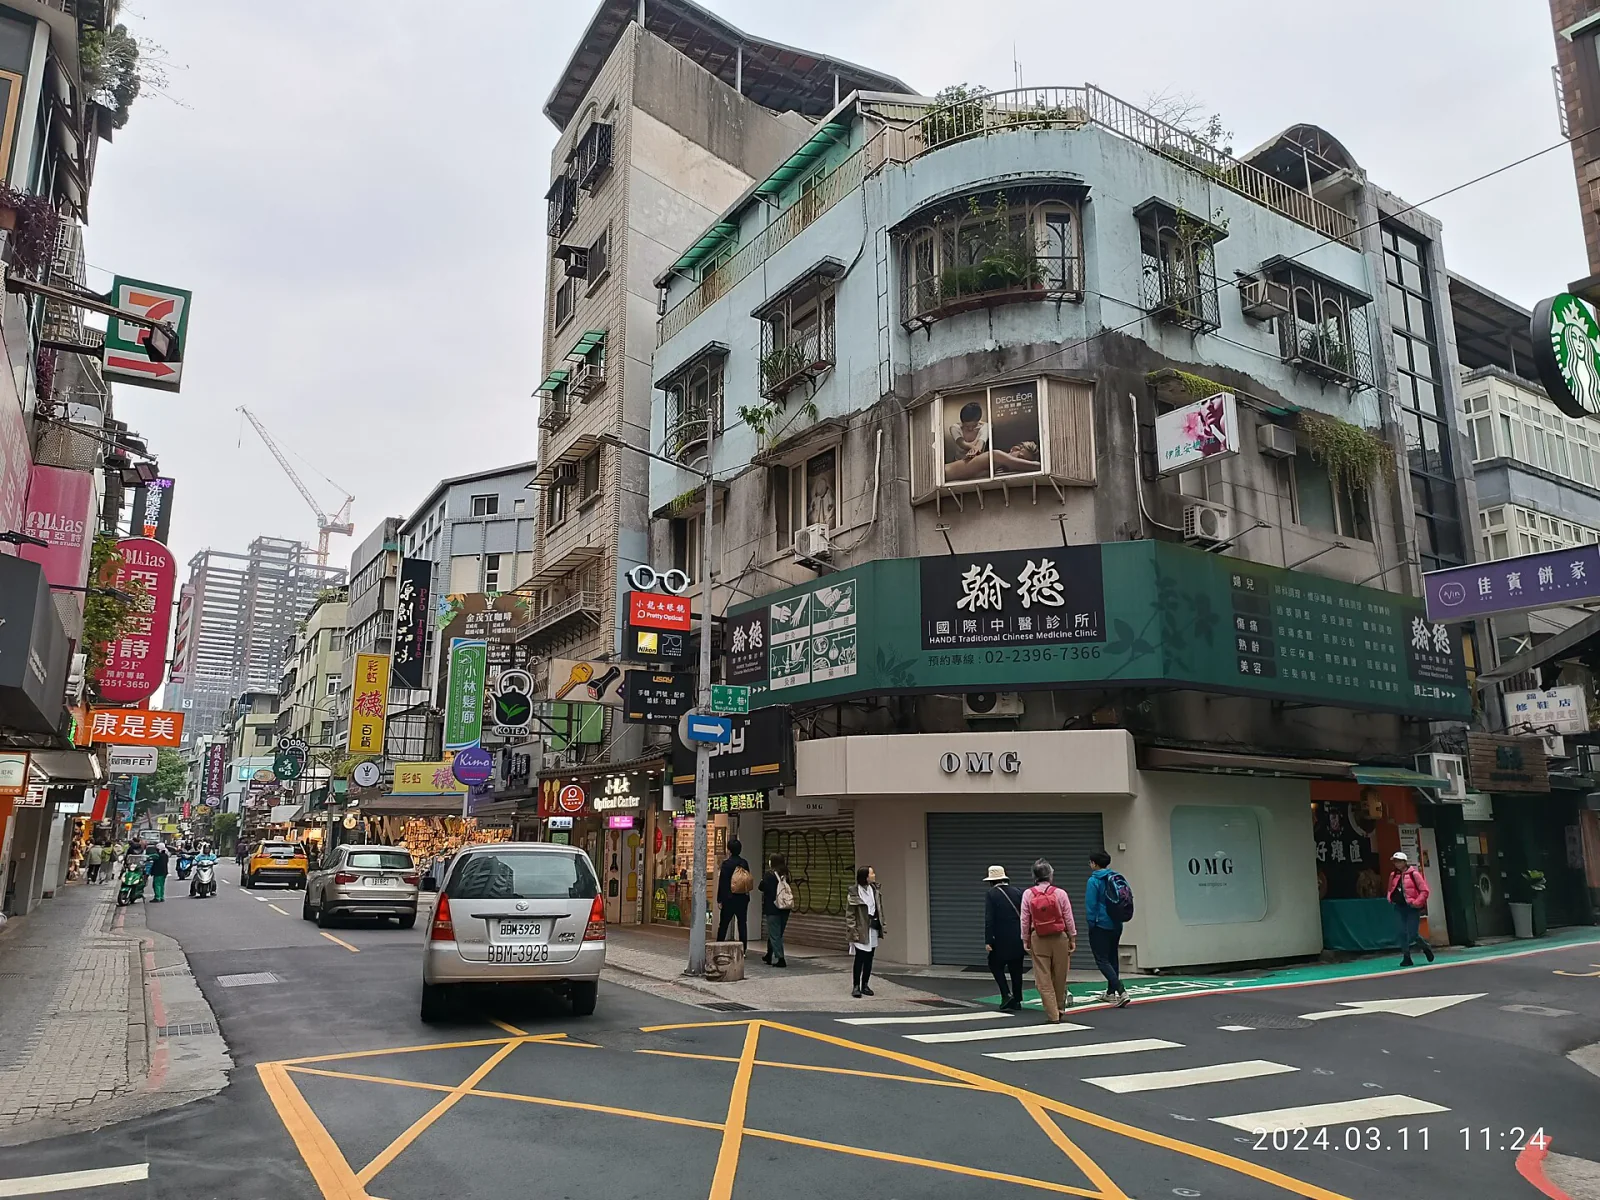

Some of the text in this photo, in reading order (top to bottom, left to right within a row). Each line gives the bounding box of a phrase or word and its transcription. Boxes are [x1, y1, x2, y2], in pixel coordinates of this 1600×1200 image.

[956, 558, 1067, 612] 翰德
[1478, 561, 1586, 596] 佳賓餅家
[415, 588, 427, 658] Pro Taste
[646, 612, 663, 620] Pretty
[935, 613, 1090, 635] 國際中醫診所
[929, 629, 1098, 644] HANDE Traditional Chinese Medicine Clinic
[985, 645, 1101, 665] 02-2396-7366
[120, 660, 141, 670] 2F
[99, 679, 150, 689] 2351-3650
[461, 665, 477, 724] 小林髮廊
[727, 697, 732, 705] 2
[184, 700, 191, 708] 9
[93, 712, 175, 740] 康是美
[940, 752, 1021, 774] OMG
[594, 796, 617, 812] Optical
[618, 795, 640, 807] Center
[1188, 858, 1234, 875] OMG
[487, 944, 549, 962] BBM-3928
